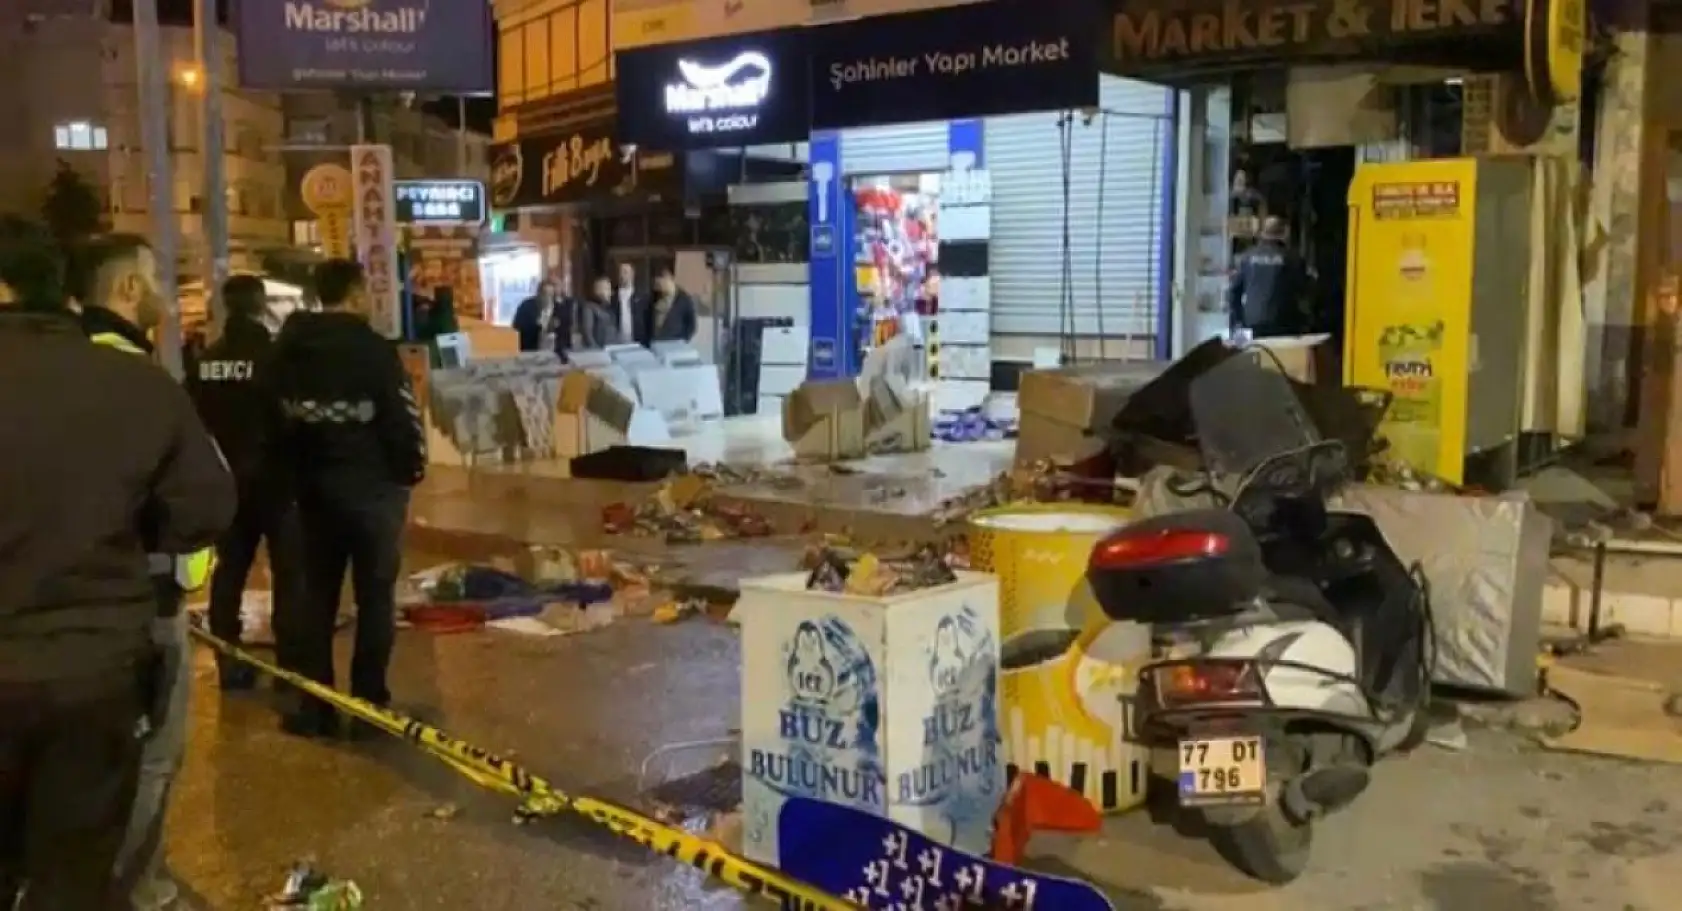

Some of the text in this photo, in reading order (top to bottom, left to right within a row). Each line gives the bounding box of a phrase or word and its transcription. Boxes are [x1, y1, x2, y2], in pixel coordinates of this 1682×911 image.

[284, 2, 418, 33] Marshall
[1325, 0, 1372, 38] &
[925, 52, 975, 75] Yapı
[982, 36, 1070, 68] Market
[779, 710, 846, 750] BUZ
[923, 702, 975, 747] BUZ
[1184, 744, 1209, 765] 77
[750, 748, 880, 806] BULUNUR
[1199, 767, 1241, 790] 796
[881, 830, 908, 870] +1
[917, 847, 943, 887] +1
[862, 859, 889, 897] +1
[953, 863, 985, 904] +1
